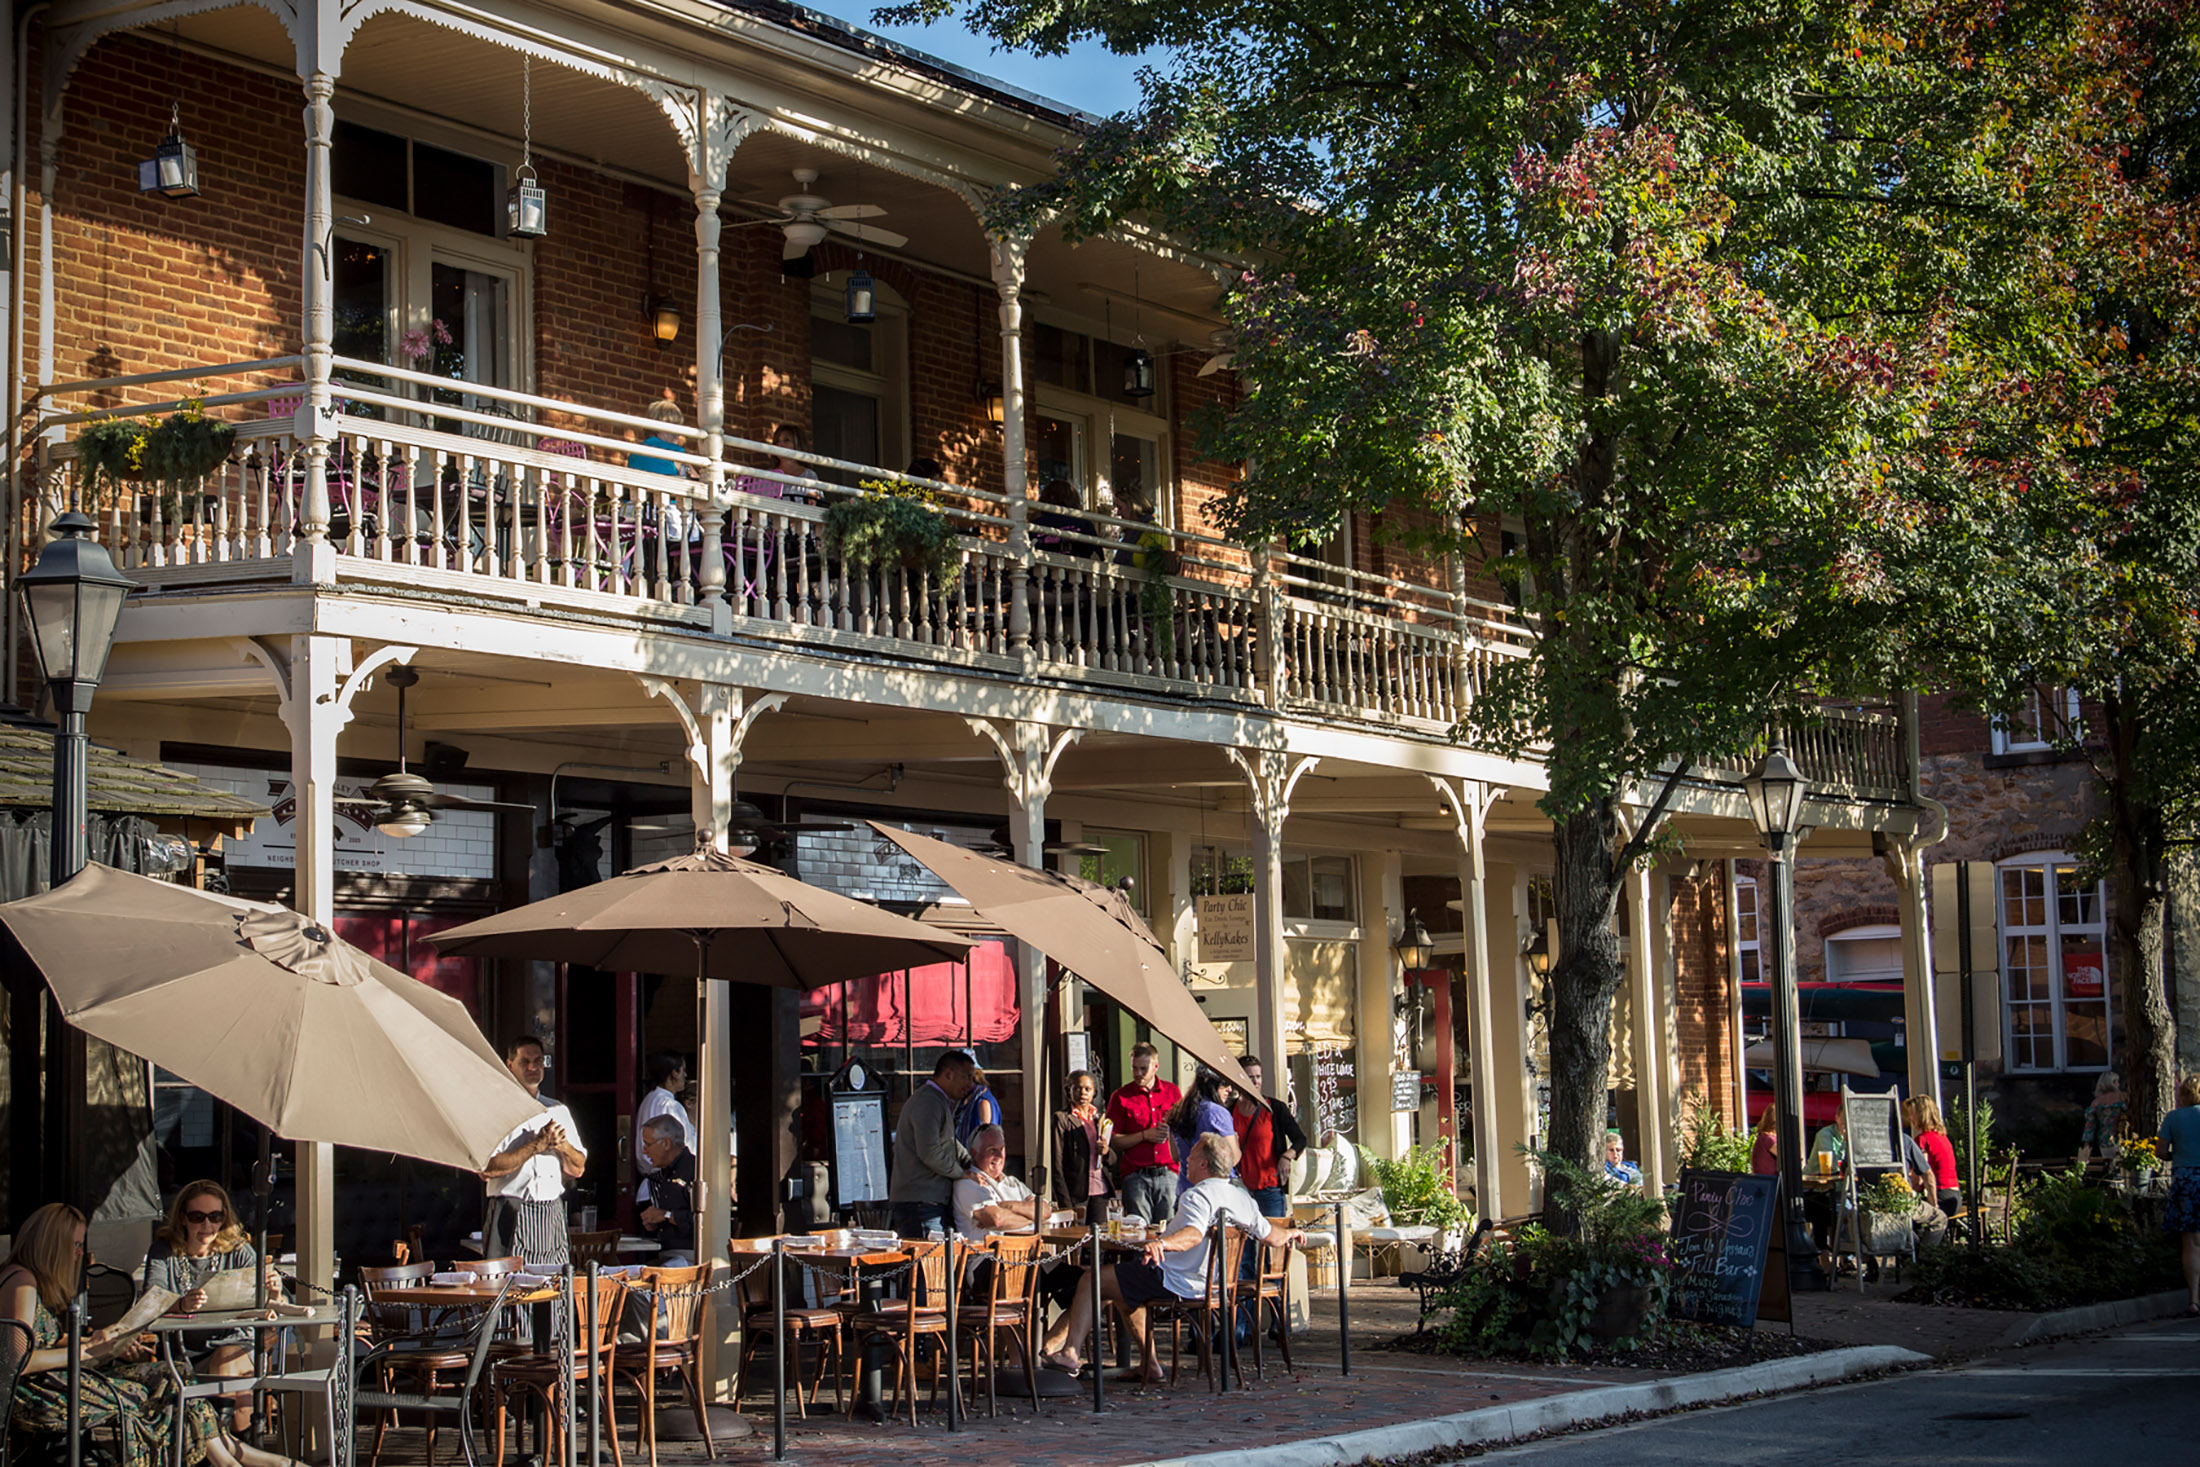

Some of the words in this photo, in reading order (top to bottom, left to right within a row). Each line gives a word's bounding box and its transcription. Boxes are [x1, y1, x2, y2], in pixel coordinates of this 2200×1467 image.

[333, 858, 359, 866] UTCHER
[1203, 900, 1225, 915] Party
[1228, 896, 1247, 912] Chic
[1203, 929, 1249, 948] KellyKakes
[1714, 1257, 1744, 1277] Bar
[1688, 1274, 1719, 1289] Music
